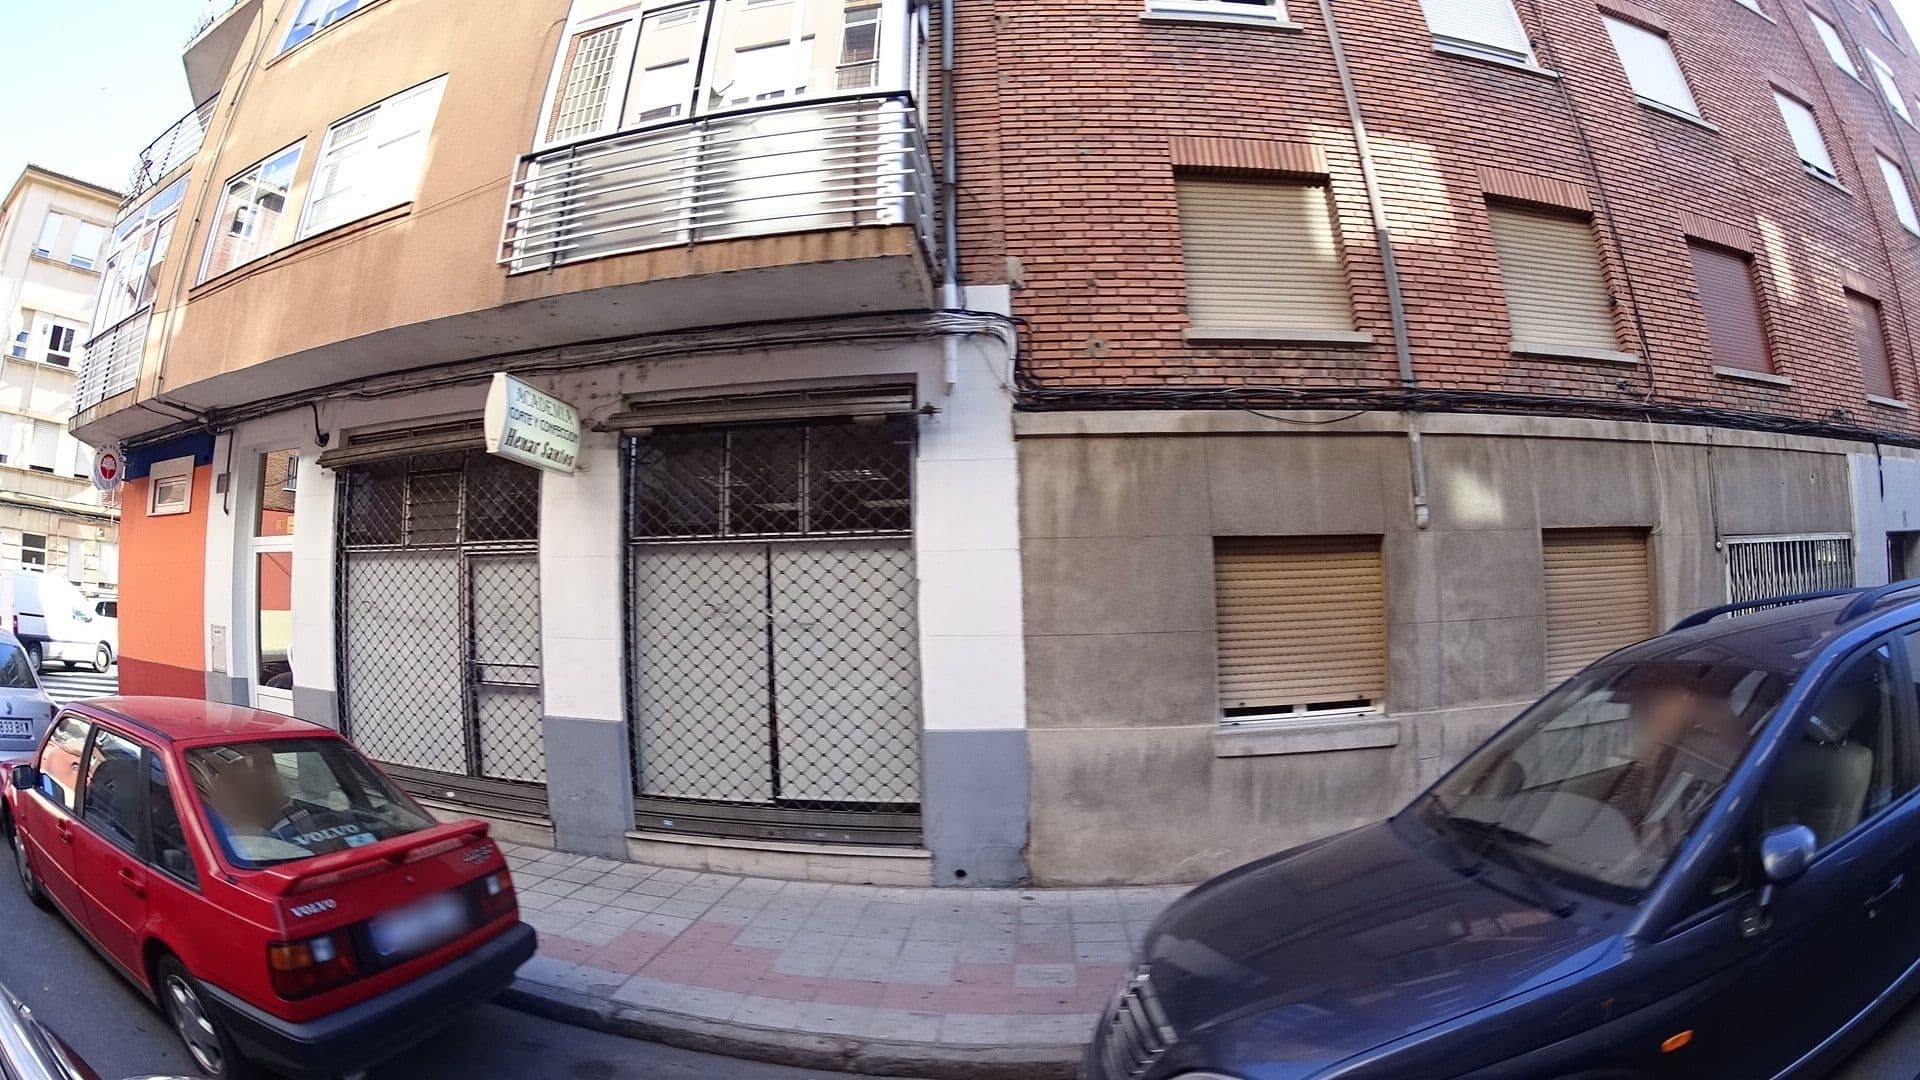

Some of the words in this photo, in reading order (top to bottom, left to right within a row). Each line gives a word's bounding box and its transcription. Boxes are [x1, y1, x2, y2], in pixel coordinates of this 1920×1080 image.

[509, 406, 533, 425] CORTE
[516, 387, 574, 425] ACADEMIA
[504, 427, 541, 454] Henar
[291, 823, 361, 846] VOLVO
[289, 898, 337, 918] VOLVO
